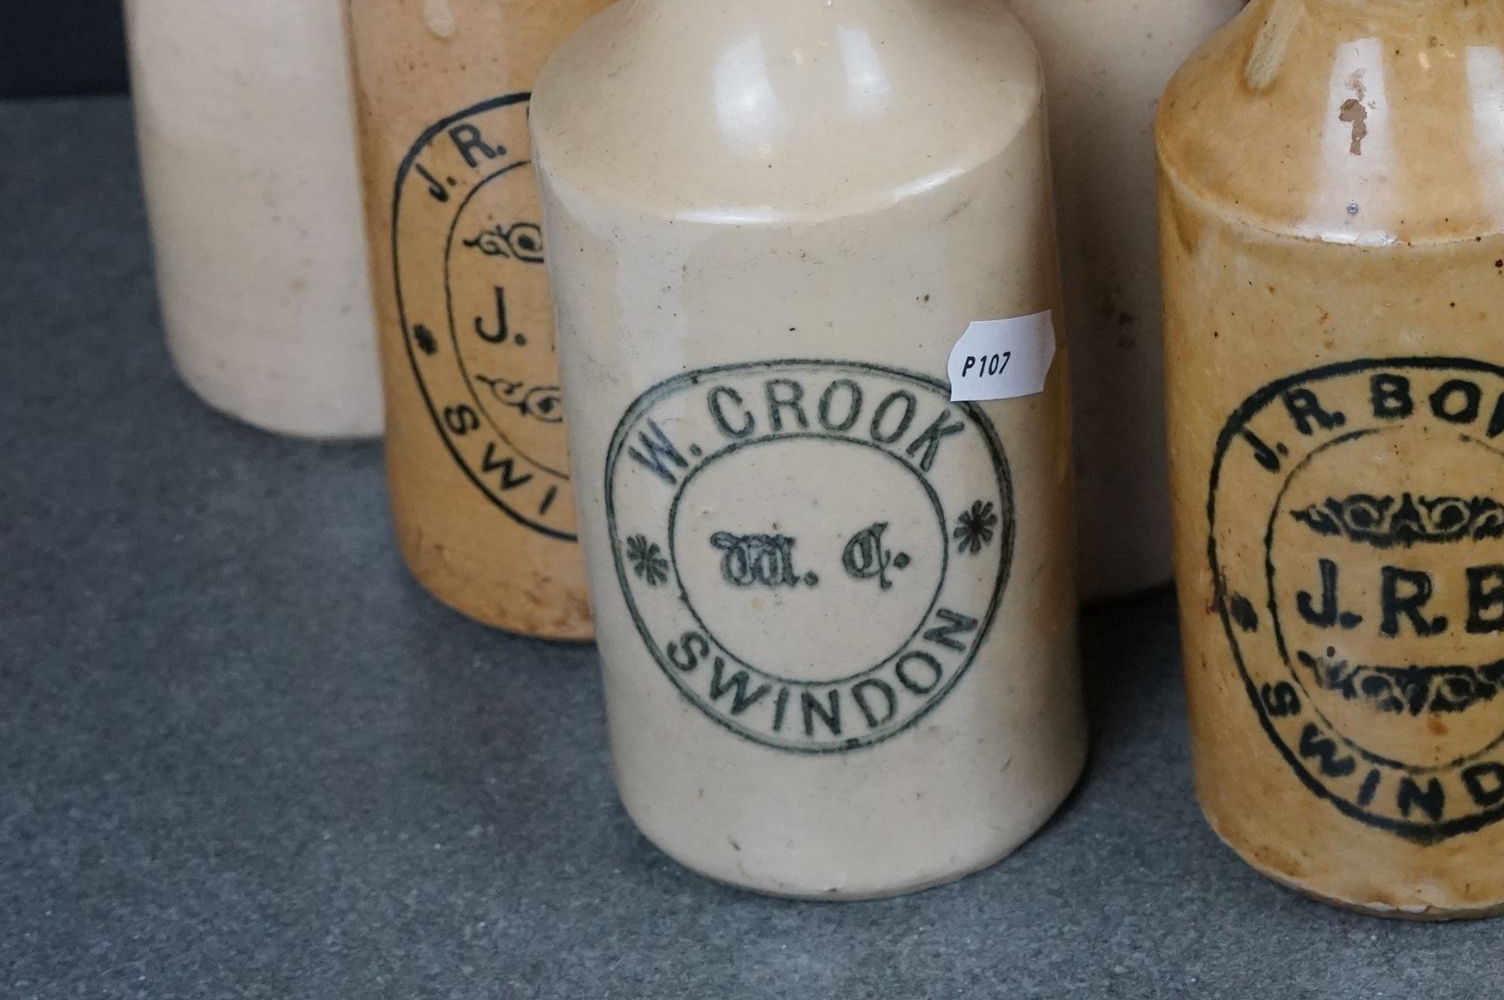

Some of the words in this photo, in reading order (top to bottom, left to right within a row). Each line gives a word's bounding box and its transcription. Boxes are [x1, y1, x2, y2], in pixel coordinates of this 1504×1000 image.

[962, 351, 1013, 378] P107
[706, 378, 966, 472] CROOK
[666, 607, 978, 736] SWINDON
